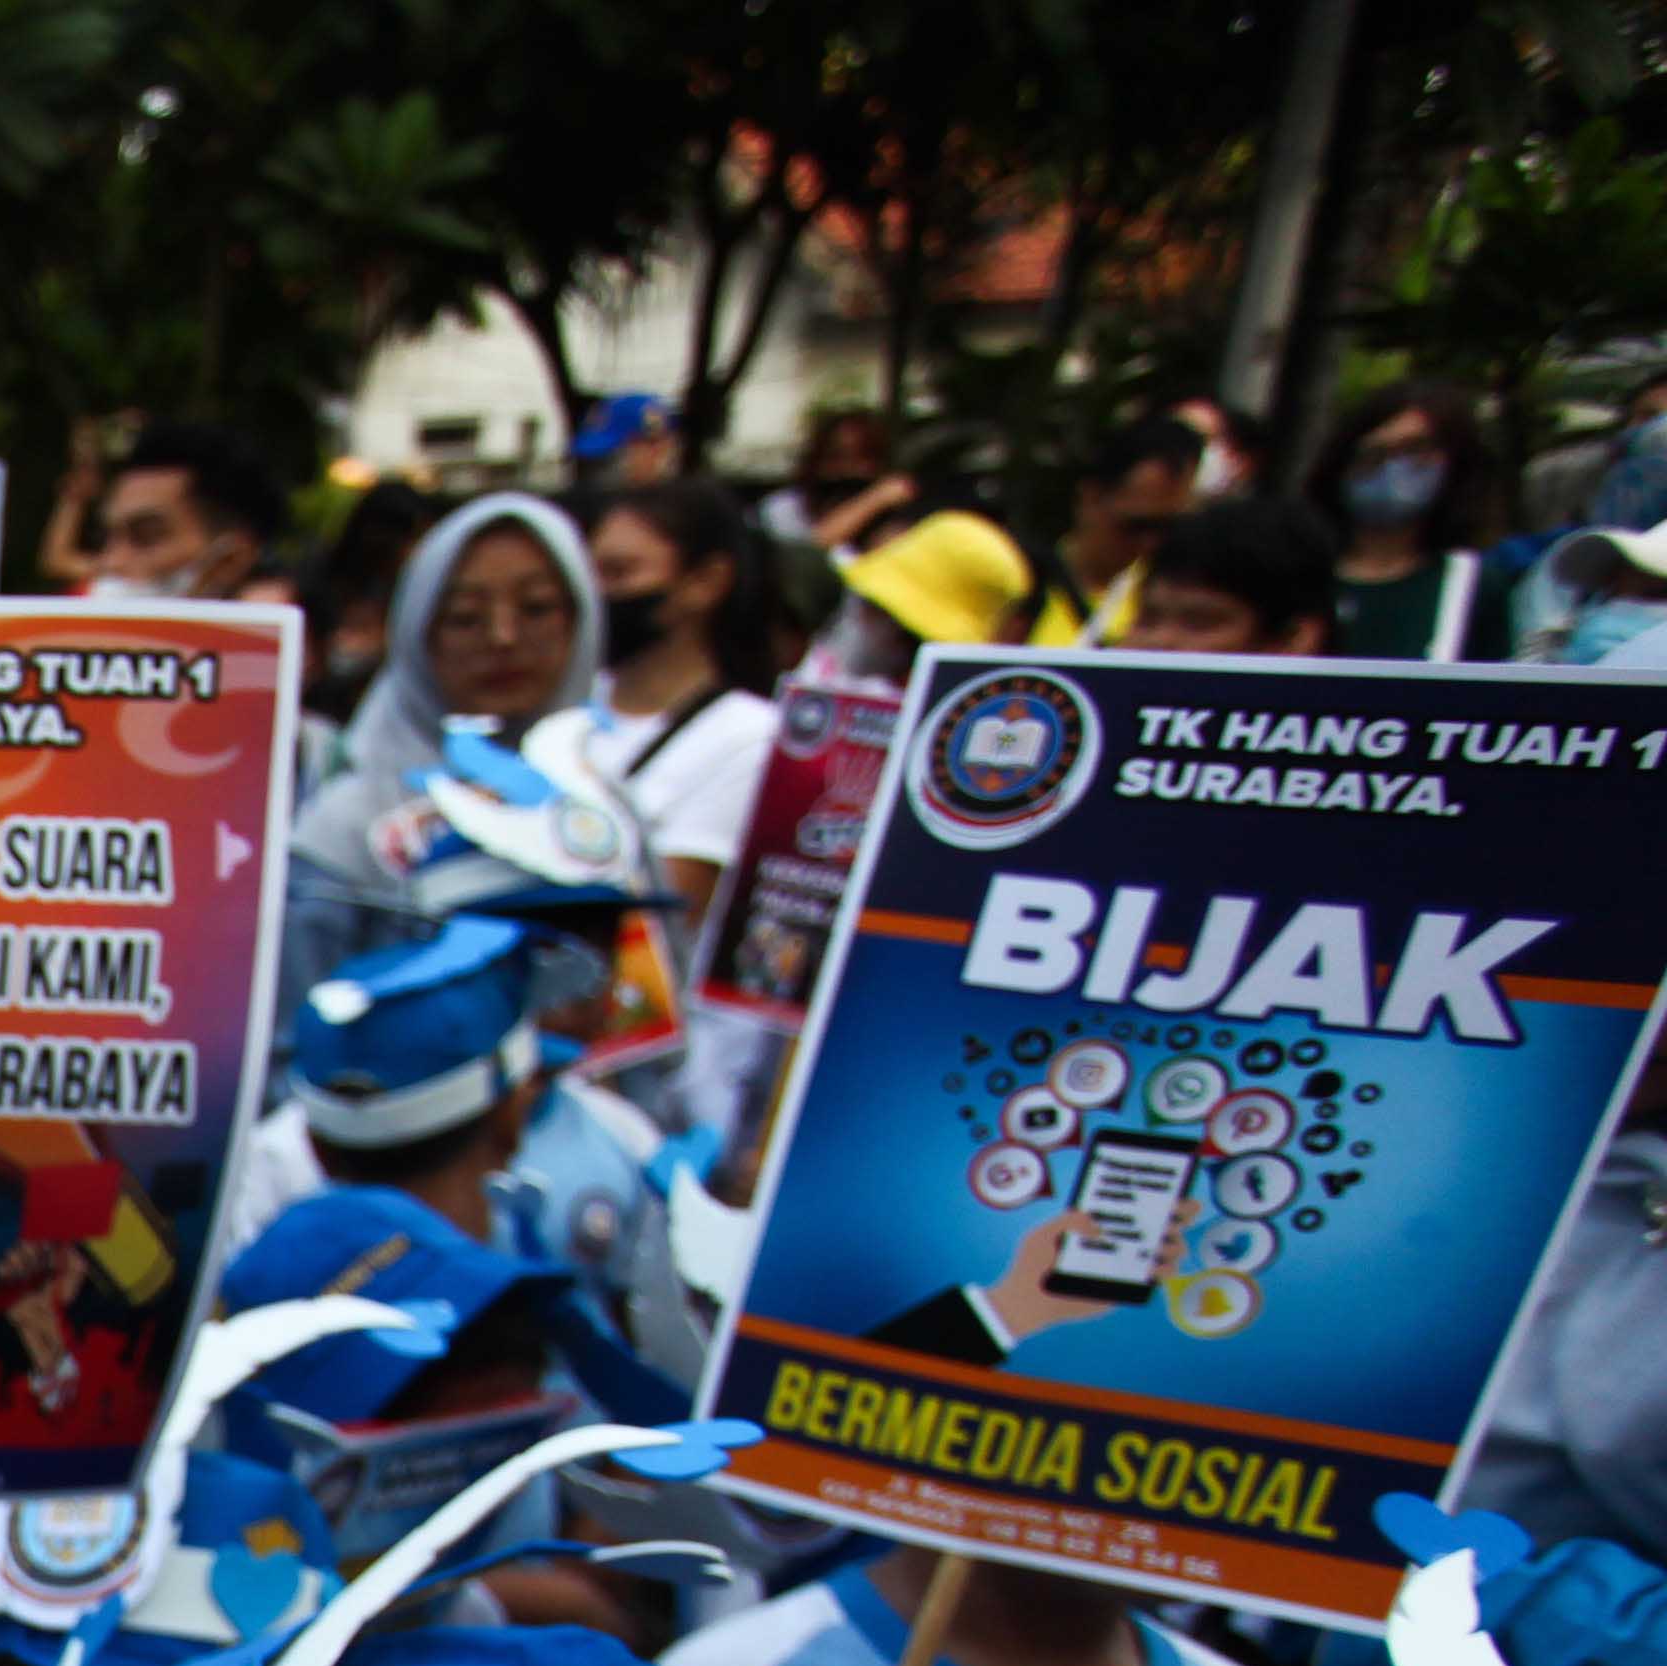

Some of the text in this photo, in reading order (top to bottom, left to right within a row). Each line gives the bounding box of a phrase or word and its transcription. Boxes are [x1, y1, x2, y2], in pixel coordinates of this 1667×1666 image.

[32, 651, 177, 698] TUAH
[189, 654, 216, 698] 1
[1135, 706, 1667, 770] TK HANG TUAH 1
[1114, 757, 1464, 818] SURABAYA.
[3, 820, 165, 894] SUARA
[25, 930, 169, 1018] KAMI,
[960, 872, 1559, 1044] BIJAK
[765, 1359, 1341, 1541] BERMEDIA SOSIAL
